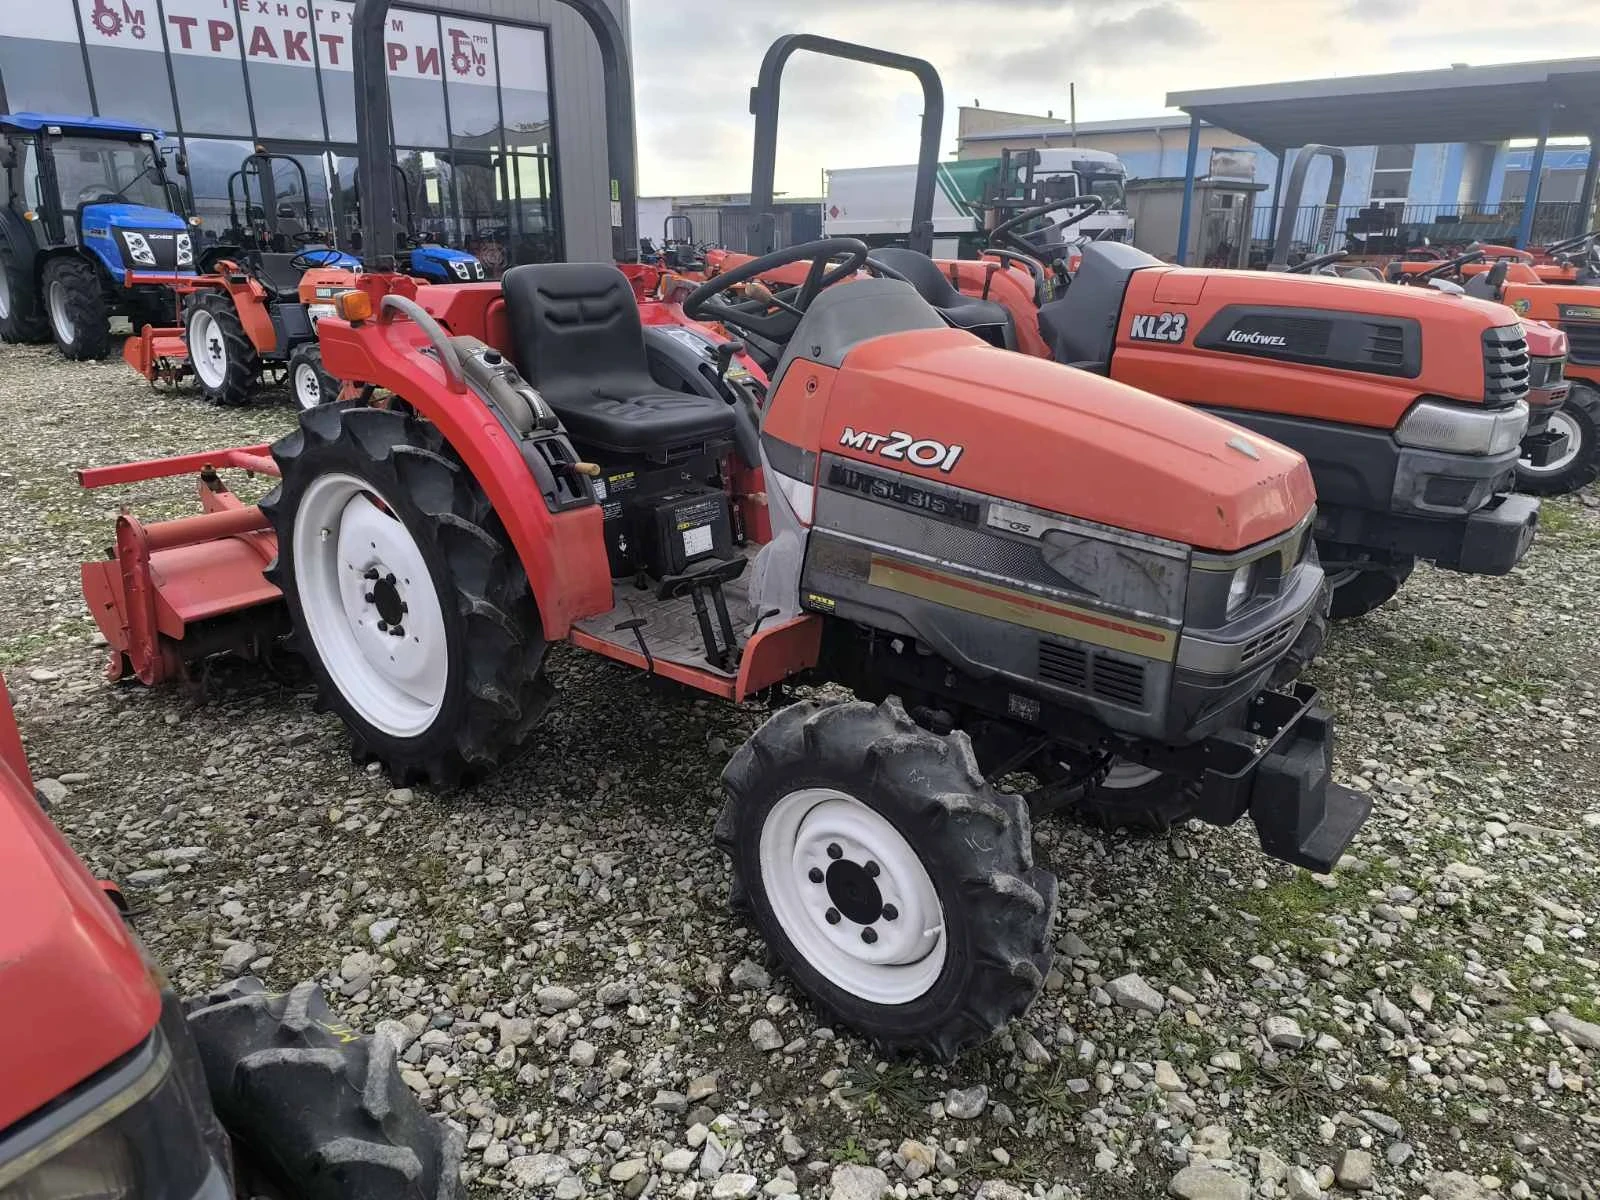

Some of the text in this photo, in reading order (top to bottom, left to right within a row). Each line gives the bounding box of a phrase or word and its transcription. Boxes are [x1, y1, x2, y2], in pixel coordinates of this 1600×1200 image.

[168, 15, 440, 75] ТРАКТРИ
[1130, 312, 1187, 342] KL23
[839, 427, 963, 472] MT201
[829, 463, 981, 525] ITSUBISH
